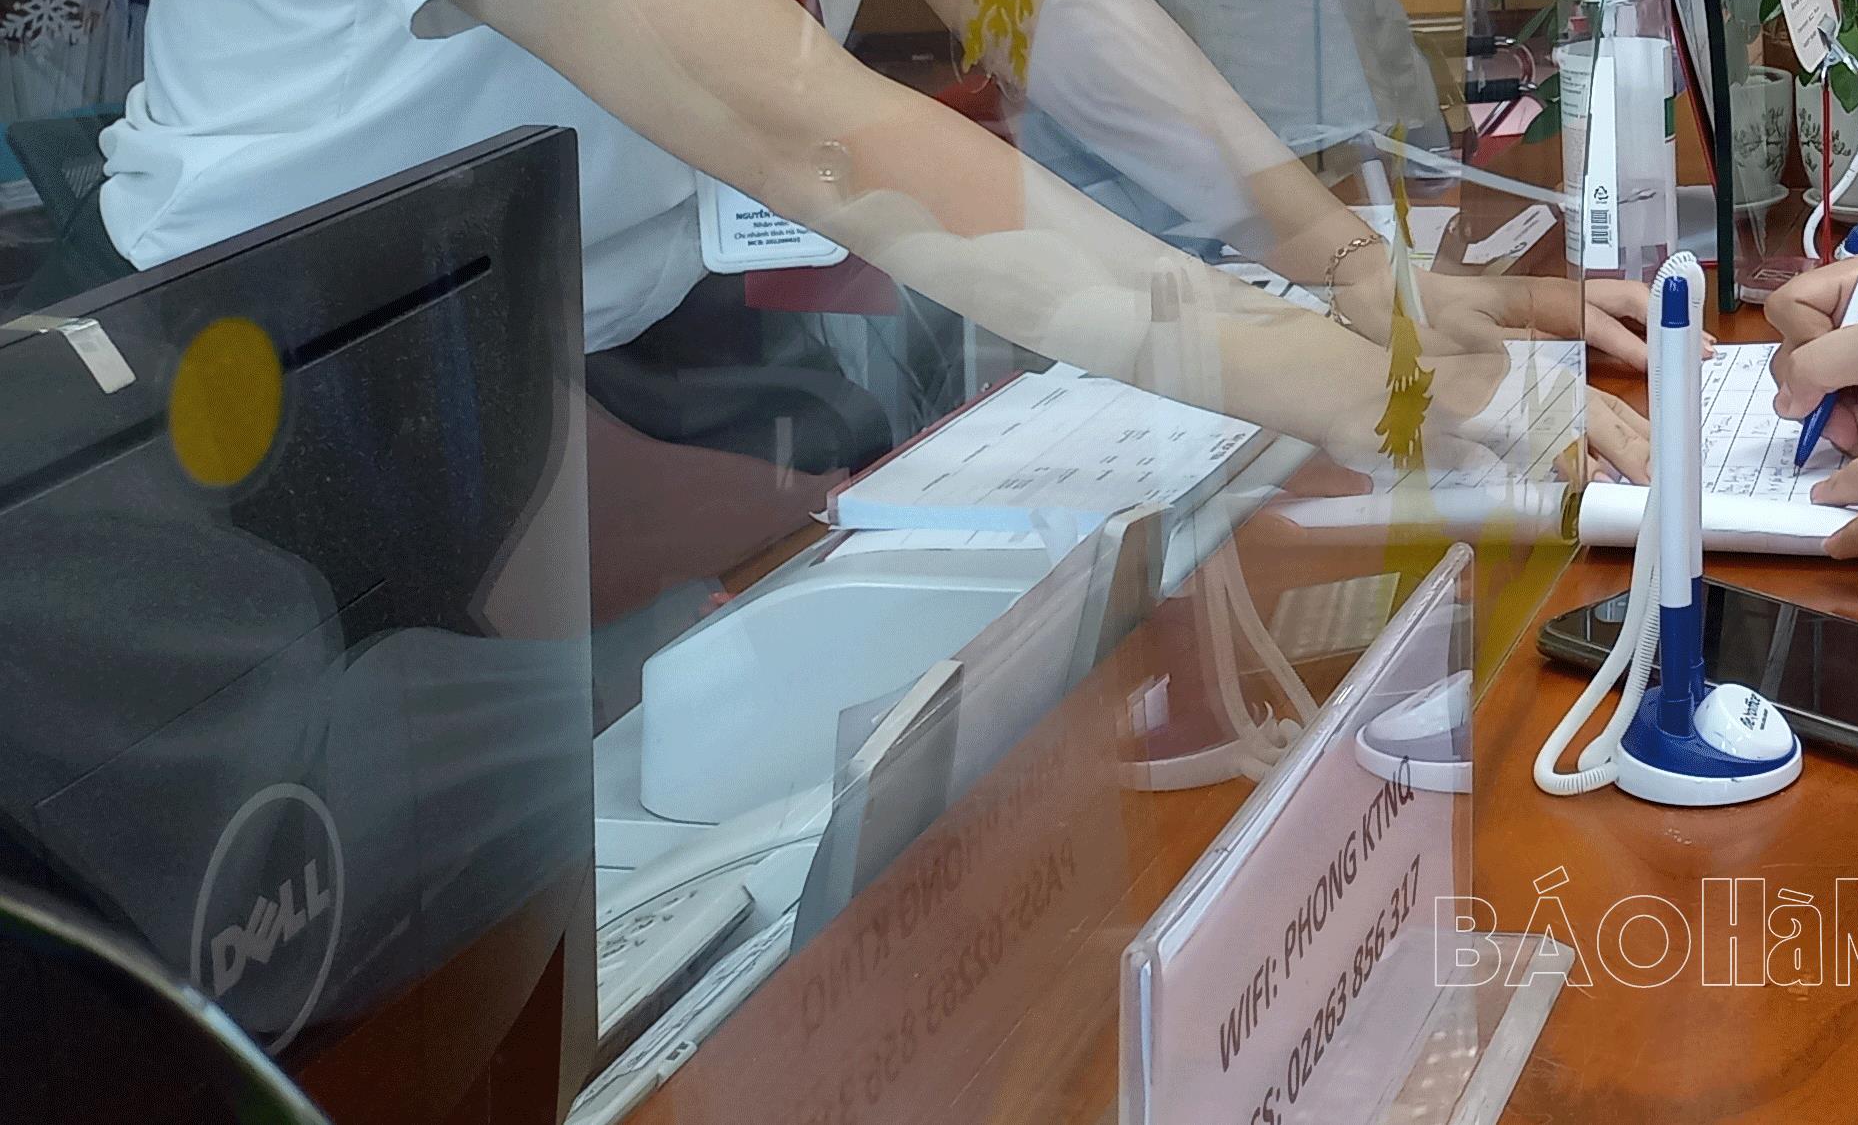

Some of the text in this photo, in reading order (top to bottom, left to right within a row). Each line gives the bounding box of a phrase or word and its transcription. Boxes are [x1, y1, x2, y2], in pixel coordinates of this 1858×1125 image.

[211, 858, 331, 998] DELL
[1220, 757, 1414, 1073] WIFI: PHONG KTNQ
[1288, 971, 1347, 1105] 02263
[1352, 909, 1386, 999] 856
[1391, 853, 1421, 941] 317
